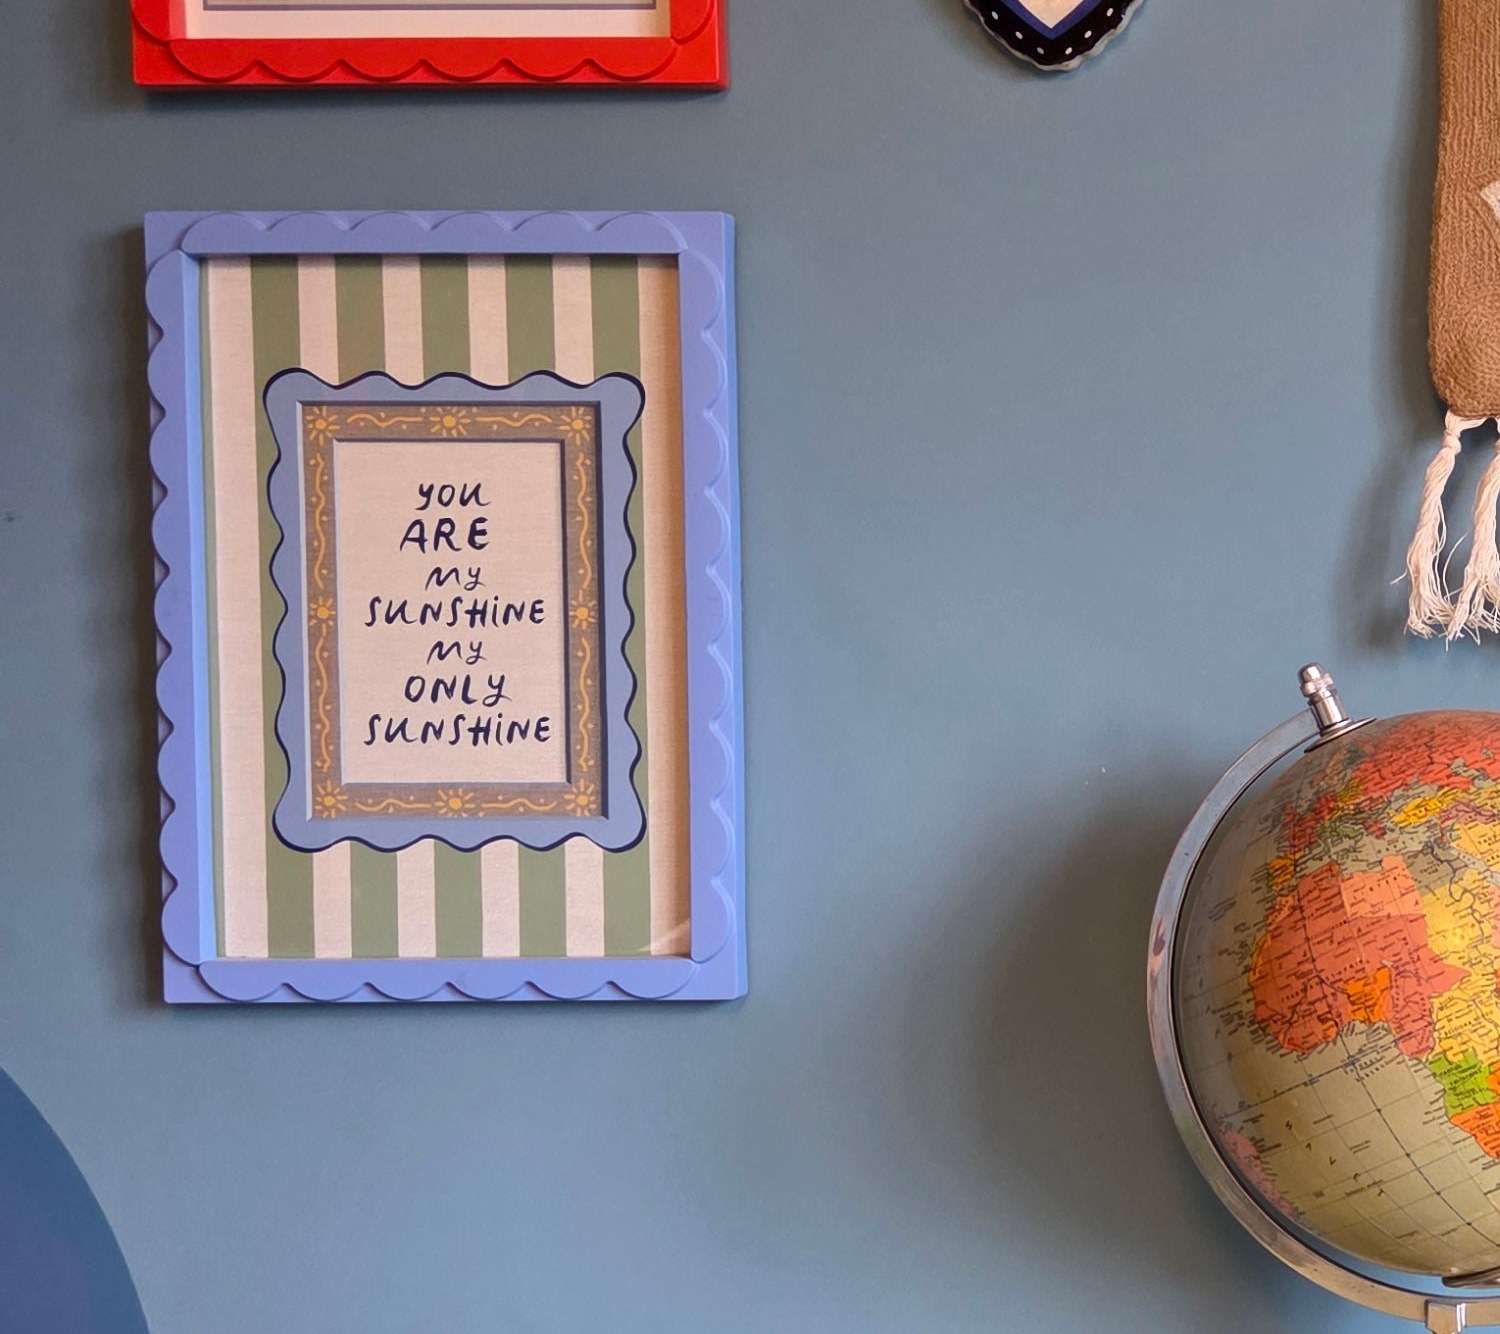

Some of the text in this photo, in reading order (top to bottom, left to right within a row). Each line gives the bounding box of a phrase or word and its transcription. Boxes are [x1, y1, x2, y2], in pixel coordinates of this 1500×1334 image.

[415, 482, 492, 511] YOU
[400, 517, 490, 554] ARE
[404, 674, 513, 708] ONLY
